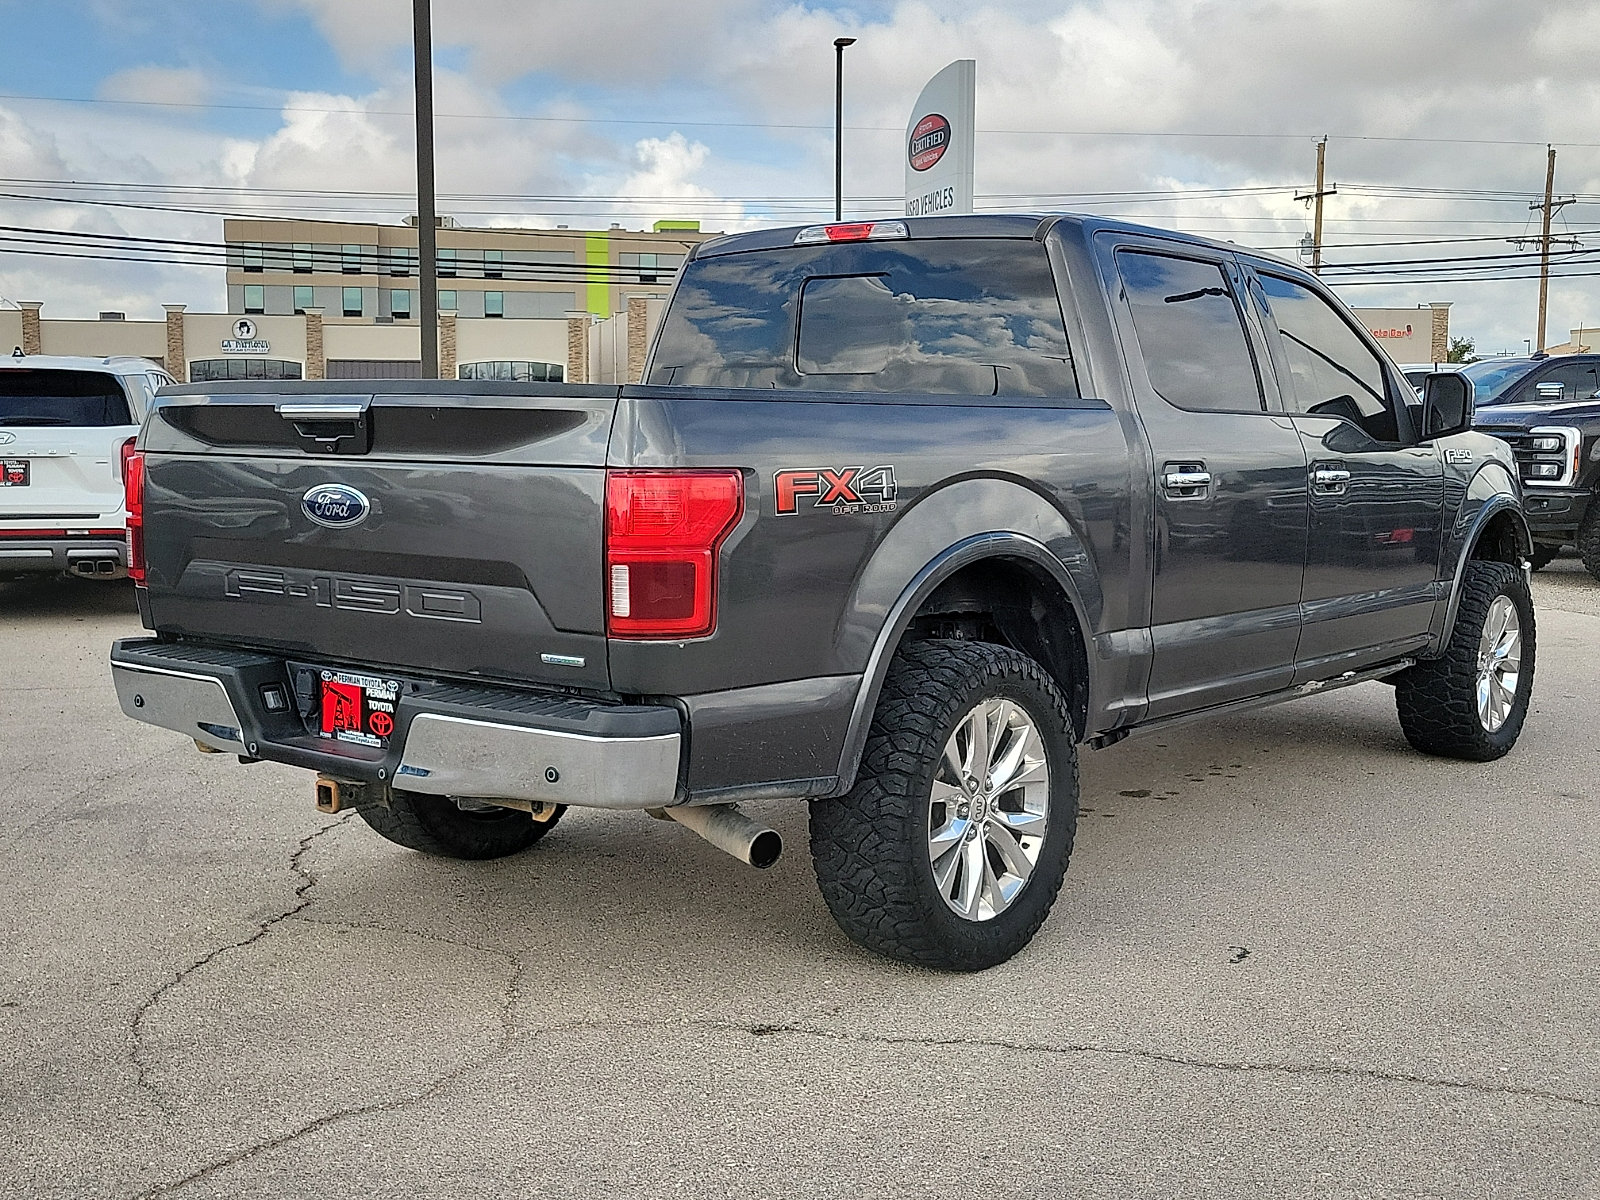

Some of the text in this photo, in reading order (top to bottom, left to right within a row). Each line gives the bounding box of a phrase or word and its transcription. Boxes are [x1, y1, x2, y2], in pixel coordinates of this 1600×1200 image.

[912, 131, 944, 155] CERTIFIED
[920, 187, 953, 215] VEHICLES
[772, 465, 897, 517] FX4
[314, 492, 350, 517] Ford
[832, 503, 897, 515] OFF ROAD
[224, 568, 482, 624] F-150
[338, 674, 382, 688] PERMIAN TOYOTA
[366, 687, 396, 701] PERMIAN
[367, 700, 394, 713] TOYOTA
